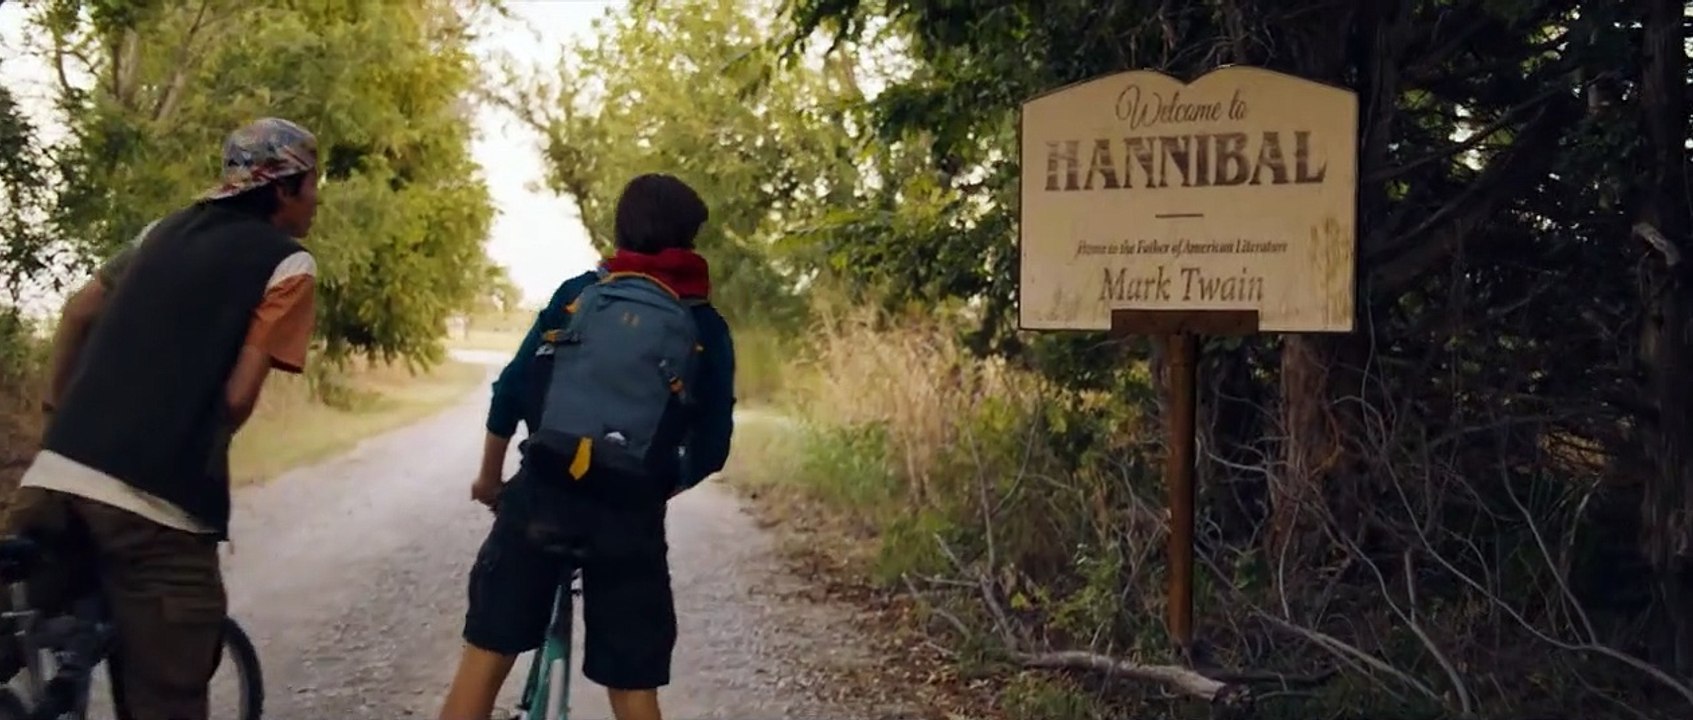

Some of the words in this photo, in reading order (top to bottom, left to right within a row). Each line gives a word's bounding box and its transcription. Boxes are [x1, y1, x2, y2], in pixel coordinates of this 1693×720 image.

[1115, 84, 1222, 130] Welcome
[1228, 89, 1247, 120] to
[1045, 131, 1328, 191] HANNIBAL
[1108, 243, 1118, 254] to
[1119, 239, 1134, 254] the
[1136, 239, 1170, 254] Father
[1171, 238, 1184, 258] of
[1183, 240, 1233, 254] American
[1235, 239, 1288, 254] Literature
[1098, 265, 1171, 302] Mark
[1180, 267, 1264, 302] Twain
